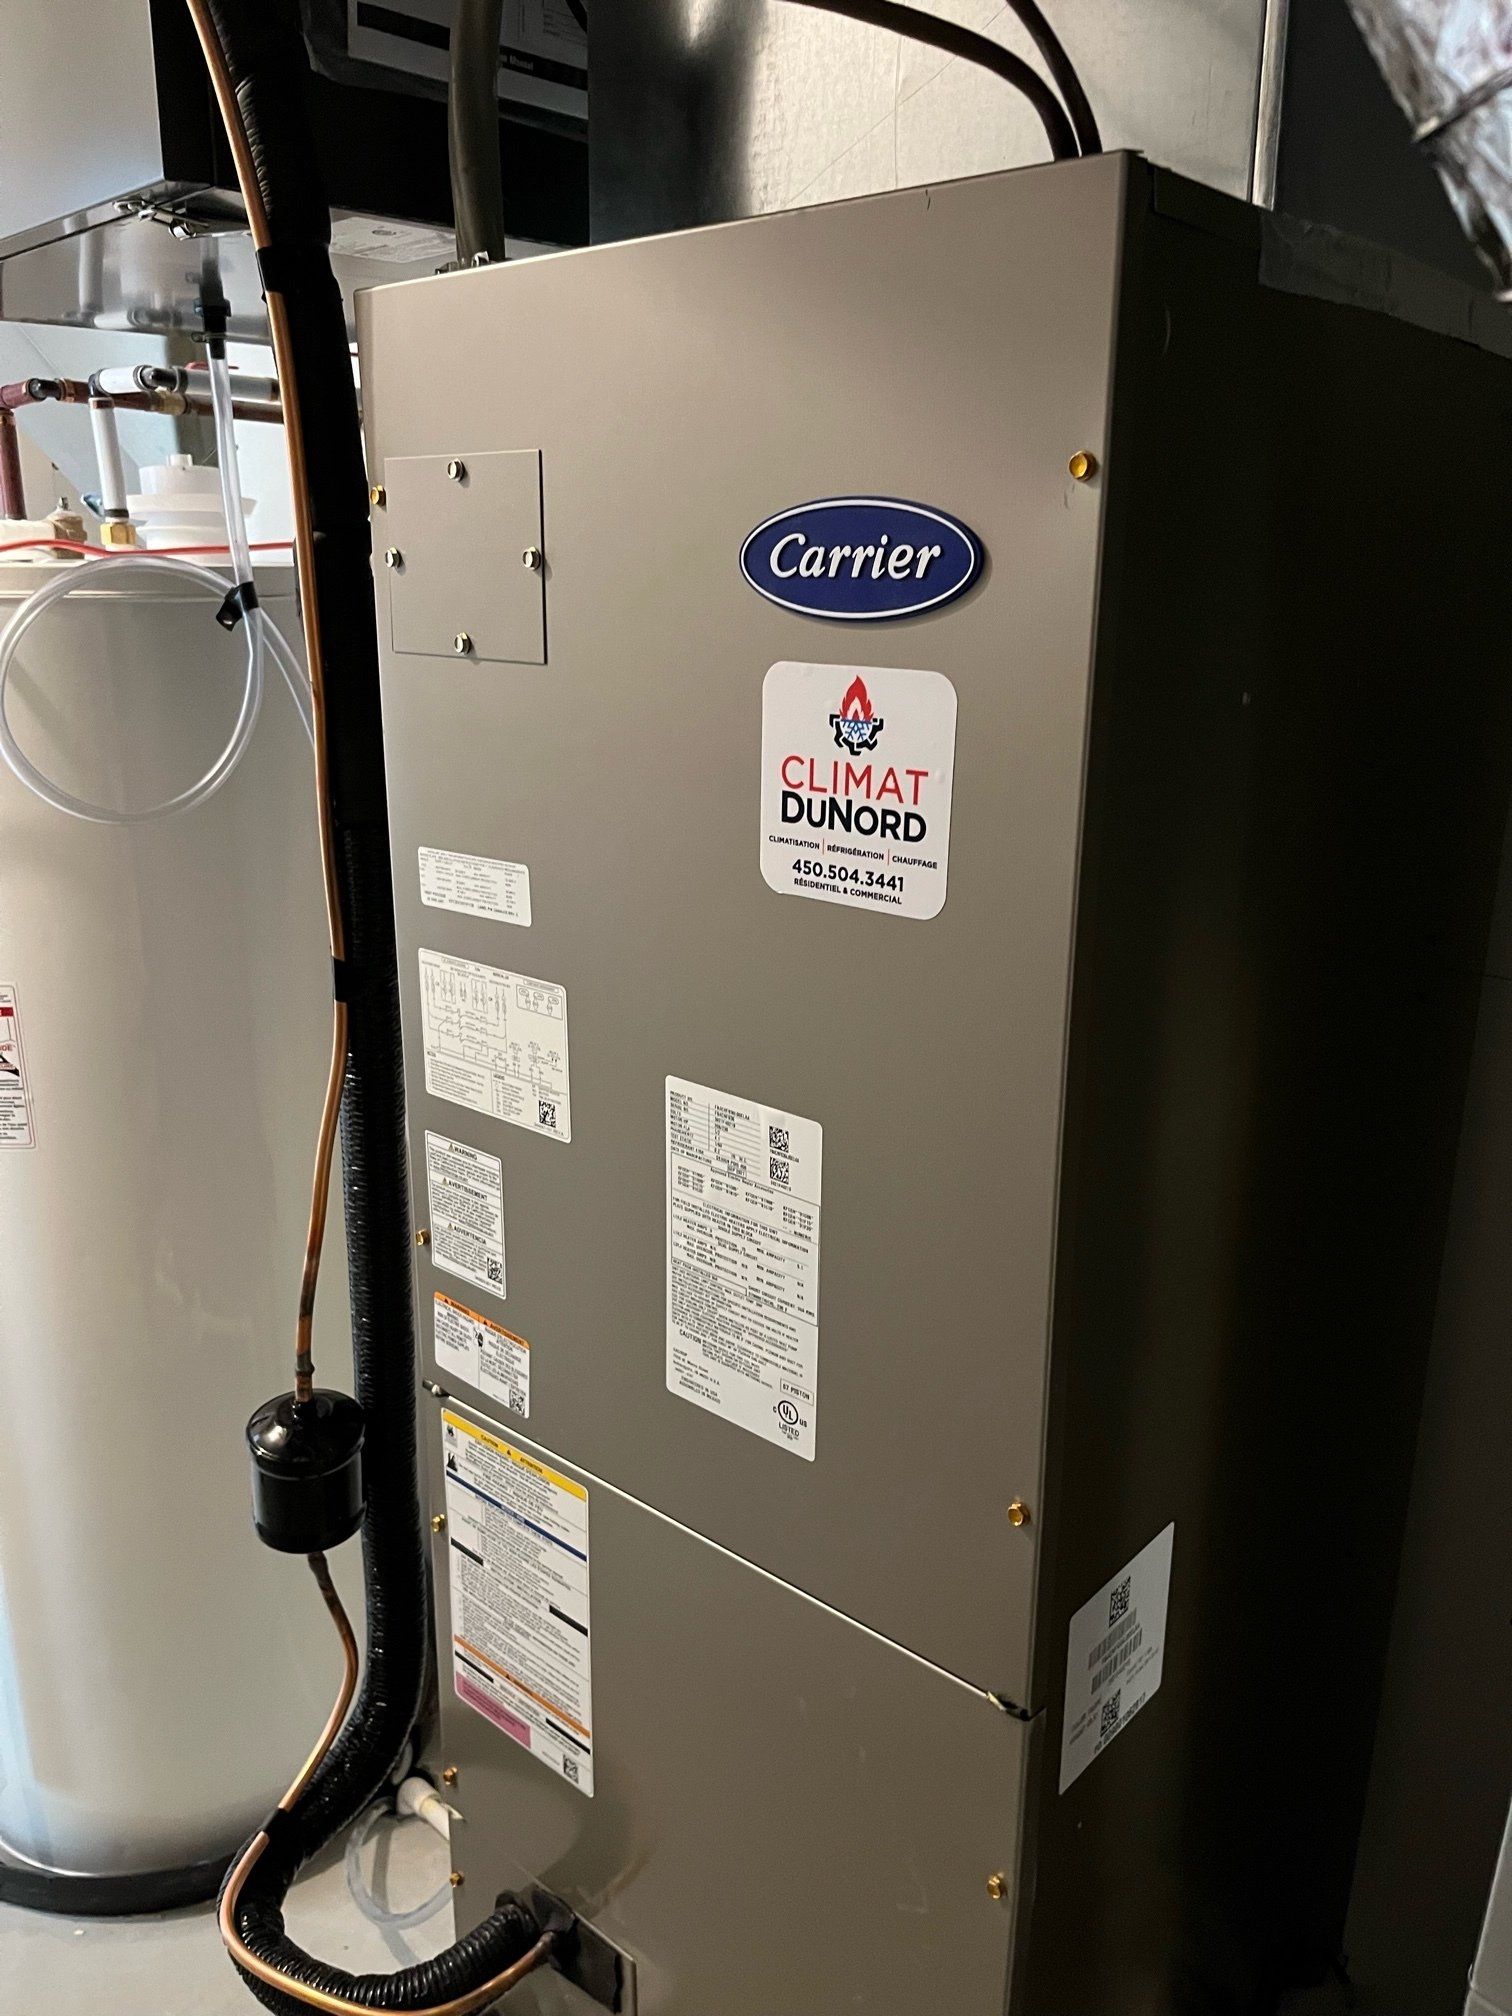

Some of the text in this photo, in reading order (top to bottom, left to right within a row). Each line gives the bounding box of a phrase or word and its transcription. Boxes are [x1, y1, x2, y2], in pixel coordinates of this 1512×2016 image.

[769, 533, 941, 579] Carrier
[781, 756, 929, 806] CLIMAT
[768, 835, 938, 870] CLIMATISATION RÉFRIGÉRATION CHAUFFAGE
[792, 859, 905, 893] 450.504.3441
[793, 877, 902, 906] RÉSIDENTIEL & COMMERCIAL
[454, 1146, 477, 1160] WARNING
[449, 1180, 487, 1201] AVERTISSEMENT
[454, 1226, 486, 1244] ADVERTENCIA
[790, 1386, 809, 1400] PISTON
[782, 1403, 794, 1421] UL
[799, 1417, 807, 1428] US
[778, 1421, 799, 1438] LISTED
